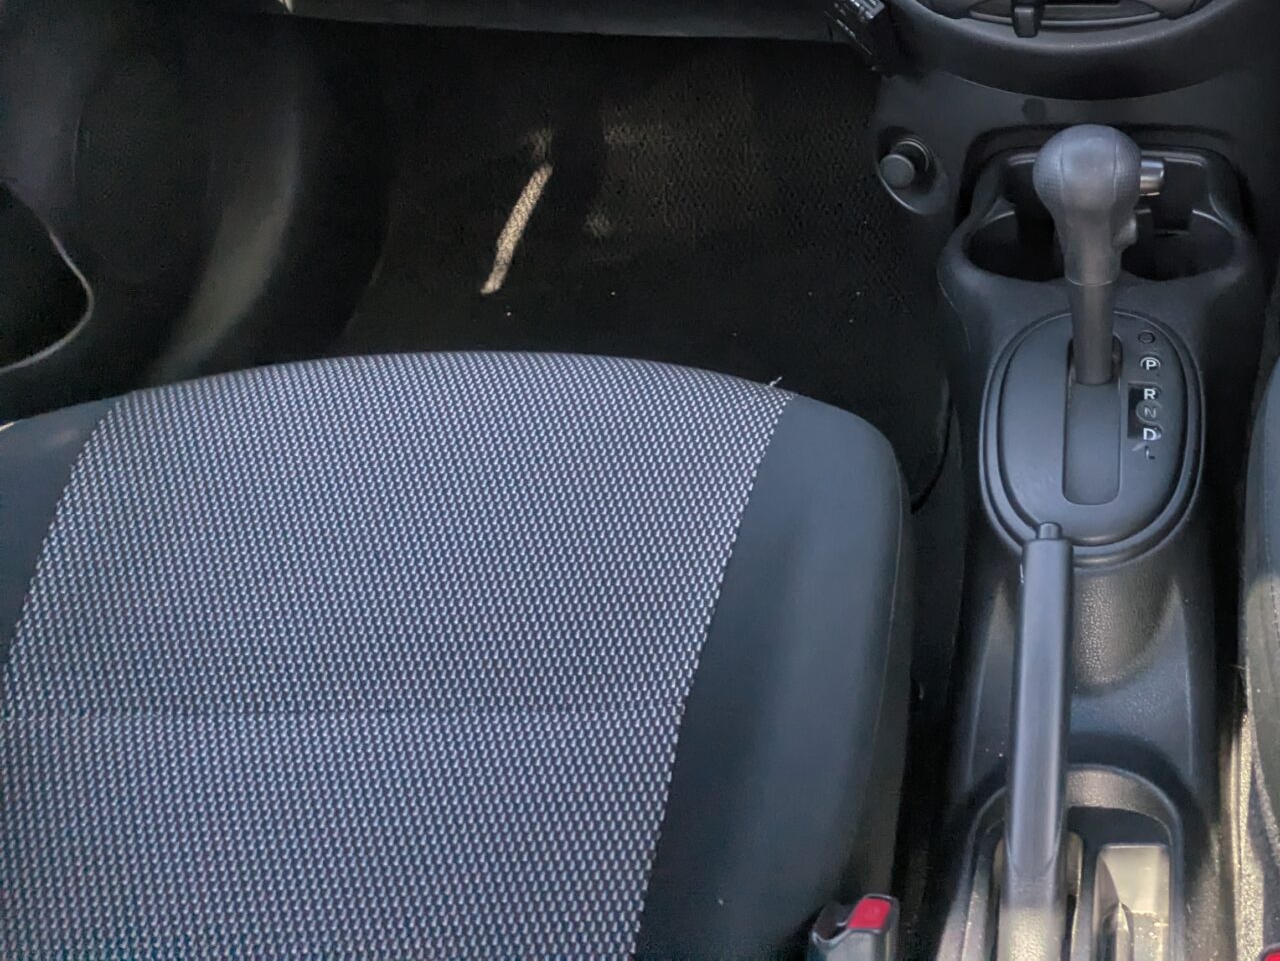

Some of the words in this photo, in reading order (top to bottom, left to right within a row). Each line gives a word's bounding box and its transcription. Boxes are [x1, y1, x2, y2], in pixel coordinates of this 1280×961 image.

[1145, 359, 1156, 370] P
[1143, 388, 1156, 400] R
[1144, 406, 1156, 418] N
[1143, 428, 1156, 441] D
